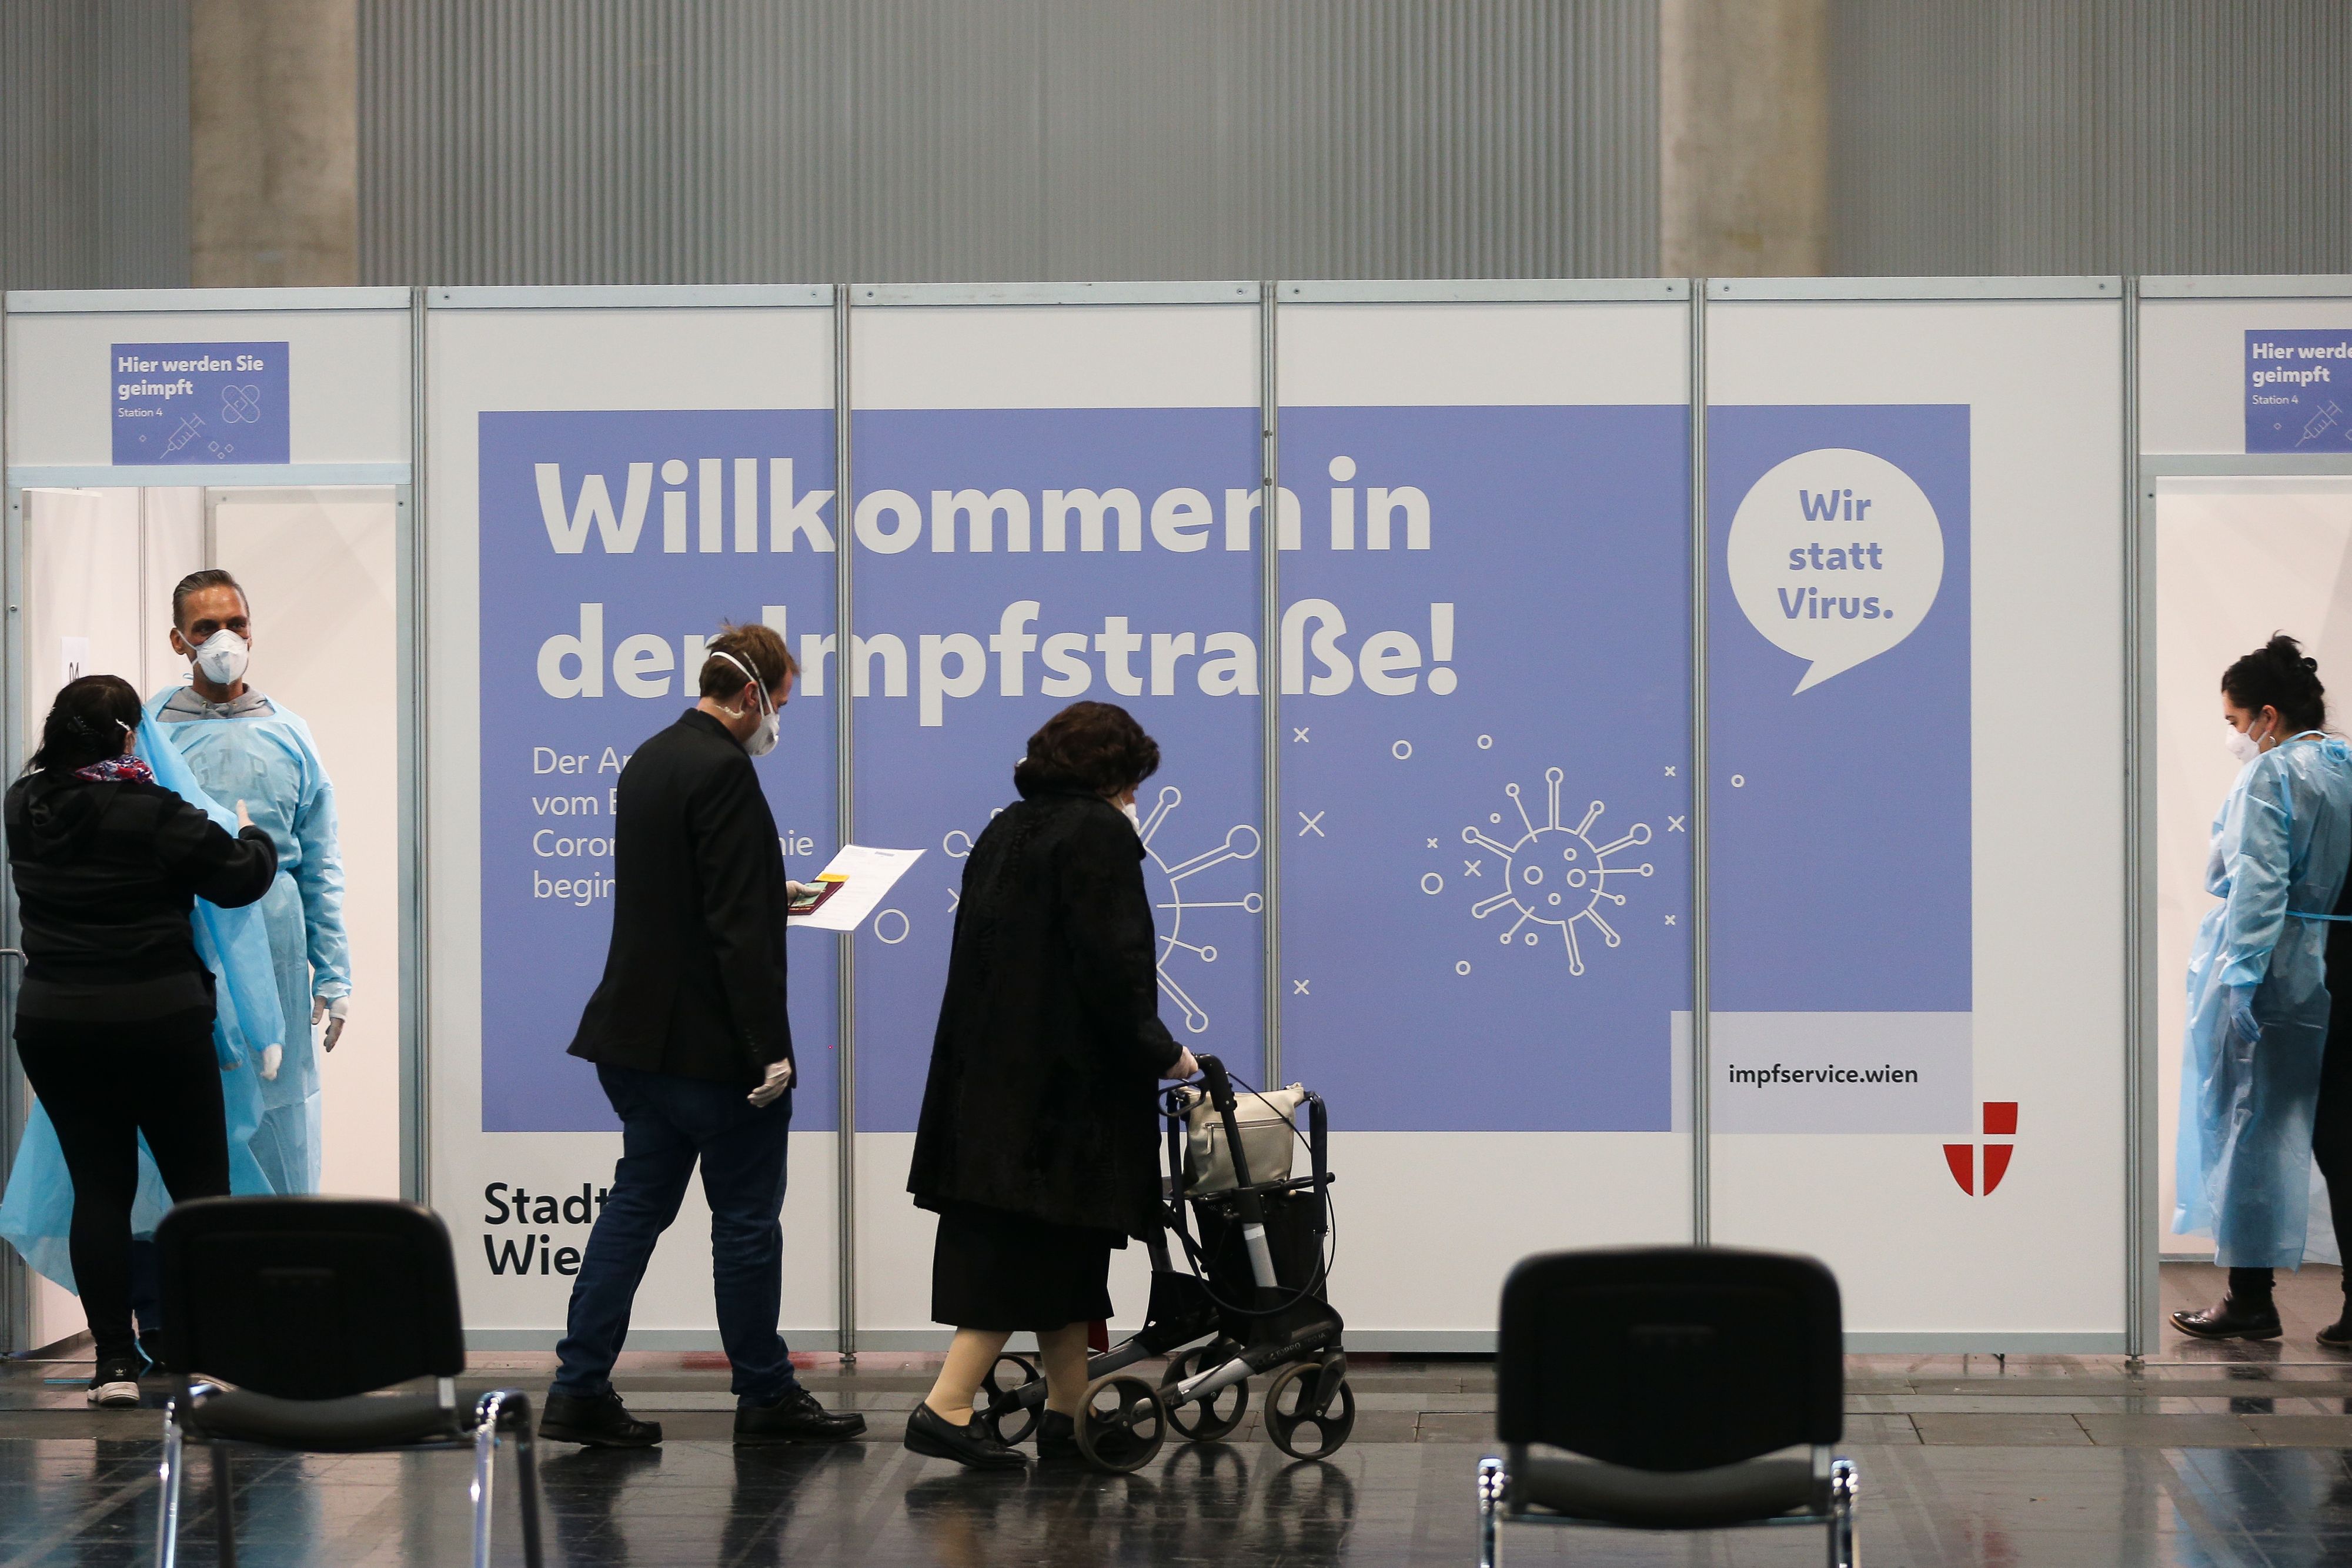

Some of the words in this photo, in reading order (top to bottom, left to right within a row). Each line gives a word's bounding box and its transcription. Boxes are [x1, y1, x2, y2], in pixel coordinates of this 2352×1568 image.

[2252, 342, 2294, 359] Hier
[118, 356, 159, 372] Hier
[162, 355, 232, 372] werden
[236, 355, 264, 371] Sie
[2252, 366, 2330, 387] geimpft
[118, 379, 193, 400] geimpft
[2252, 394, 2290, 404] Station
[2291, 394, 2298, 404] 4
[118, 407, 154, 417] Station
[156, 408, 163, 416] 4
[534, 458, 1301, 554] Willkommen
[1328, 456, 1431, 550] in
[1799, 489, 1872, 521] Wir
[1789, 543, 1882, 570] statt
[1778, 587, 1894, 619] Virus.
[533, 747, 589, 774] Der
[532, 796, 598, 815] vom
[1729, 1064, 1918, 1088] impfservice.wien
[483, 1234, 582, 1276] Wie
